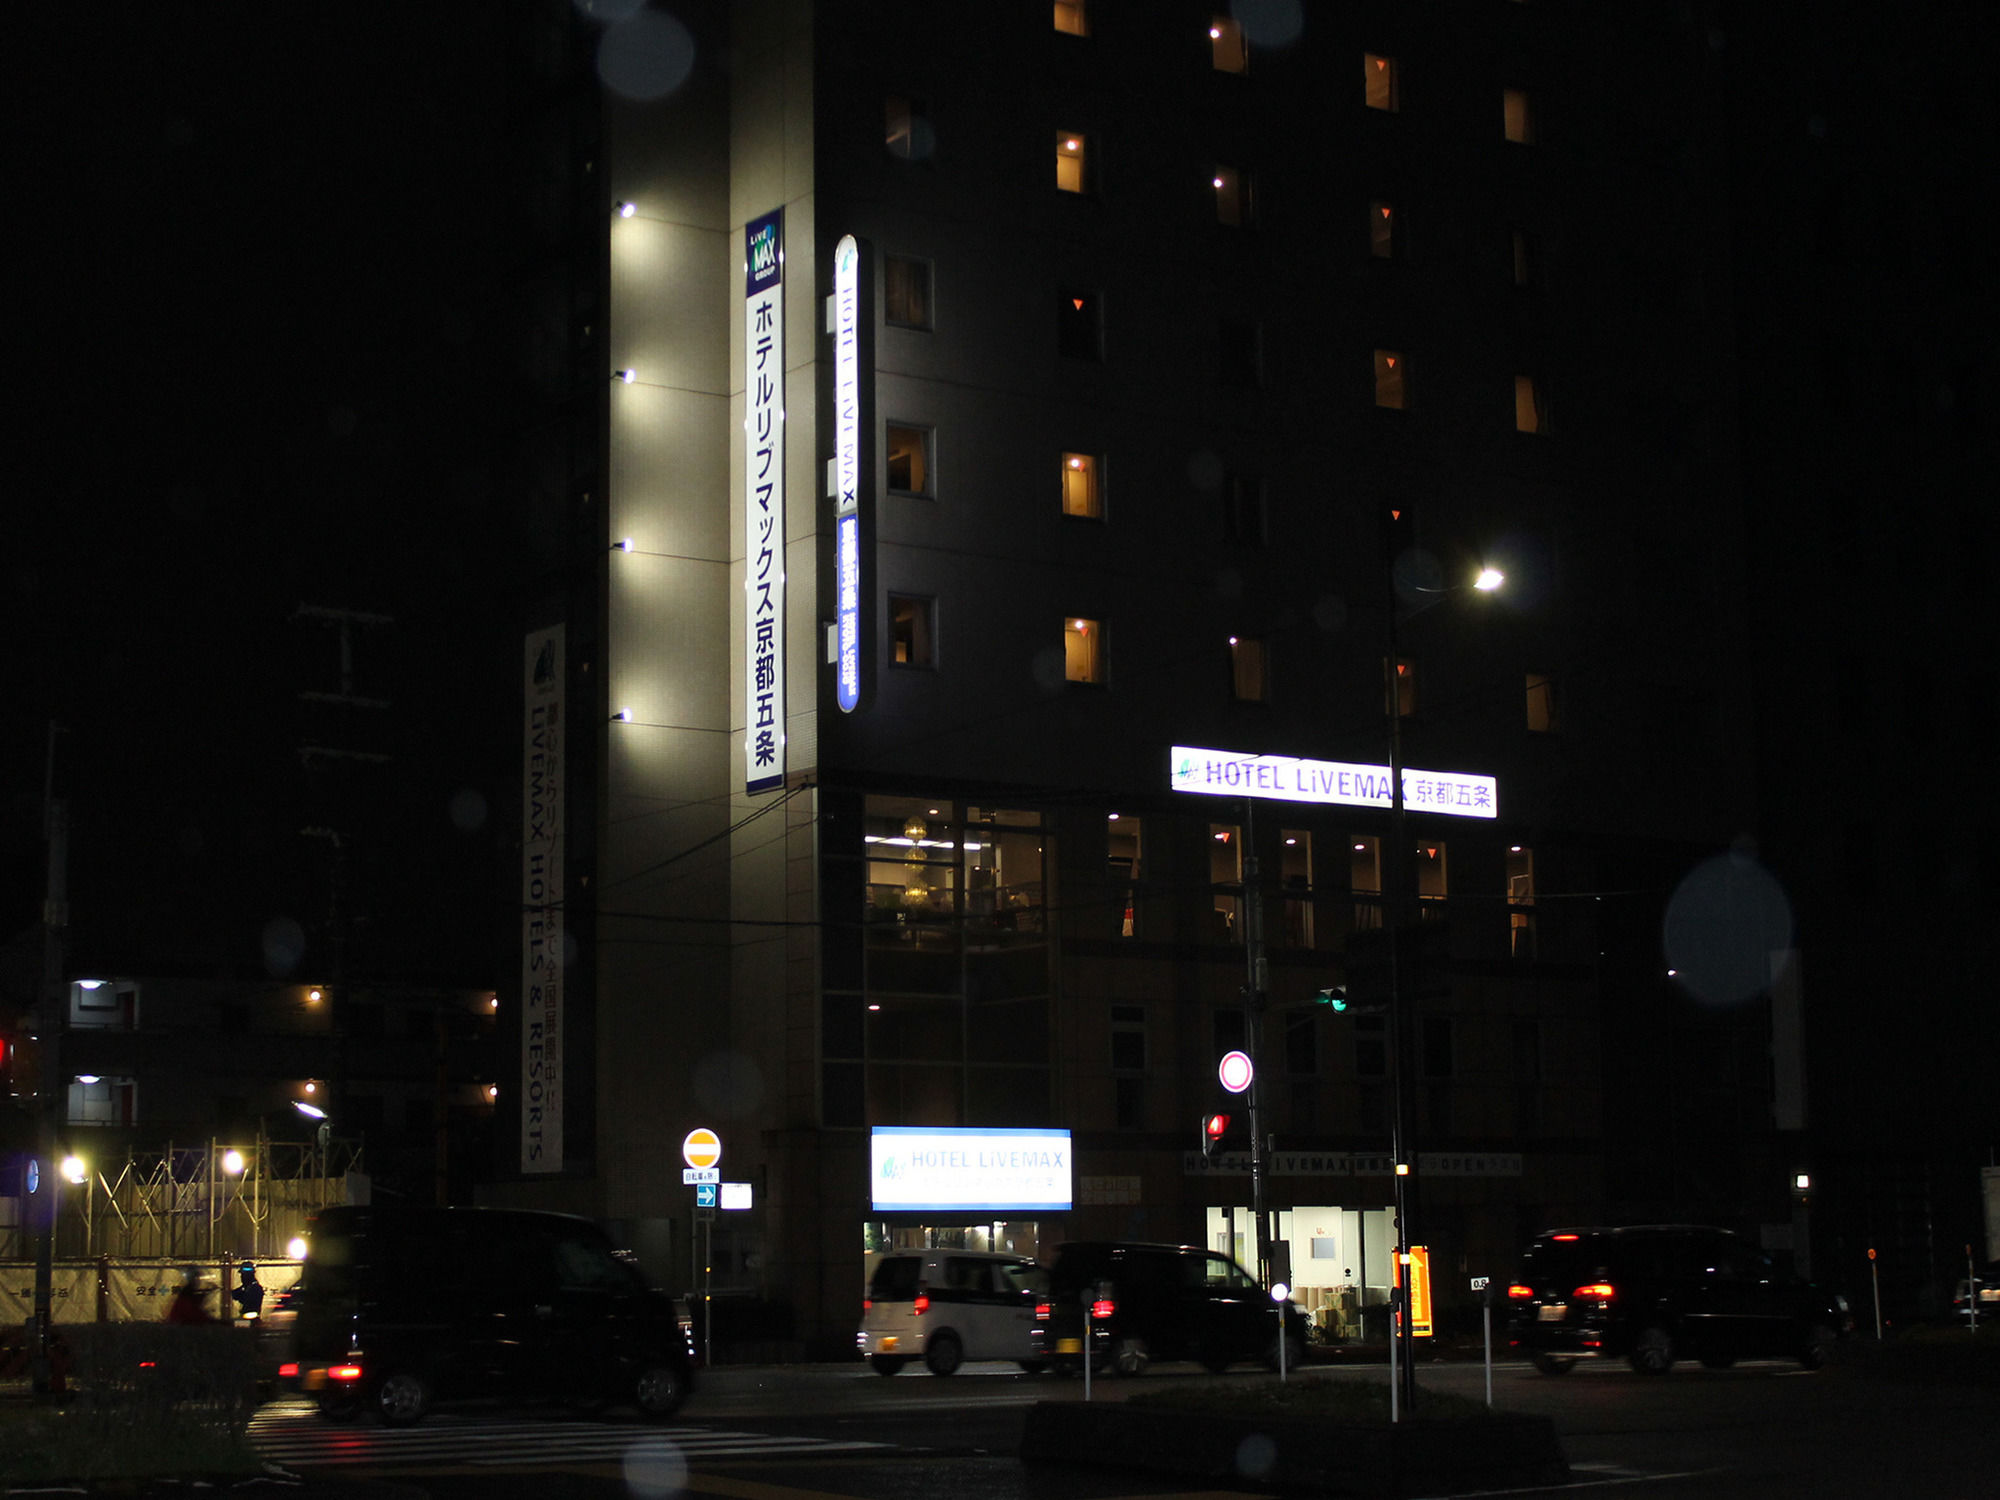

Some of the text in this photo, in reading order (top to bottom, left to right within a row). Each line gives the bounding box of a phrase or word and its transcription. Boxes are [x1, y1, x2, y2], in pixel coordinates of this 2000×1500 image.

[754, 237, 776, 272] MAX
[755, 301, 775, 768] ホテルリブマックス京都五条
[1206, 760, 1285, 791] HOTEL
[1416, 779, 1491, 808] 京都五条
[530, 855, 544, 971] HOTELS
[529, 985, 542, 1007] &
[529, 1023, 543, 1161] RESORTS
[912, 1151, 971, 1168] HOTEL
